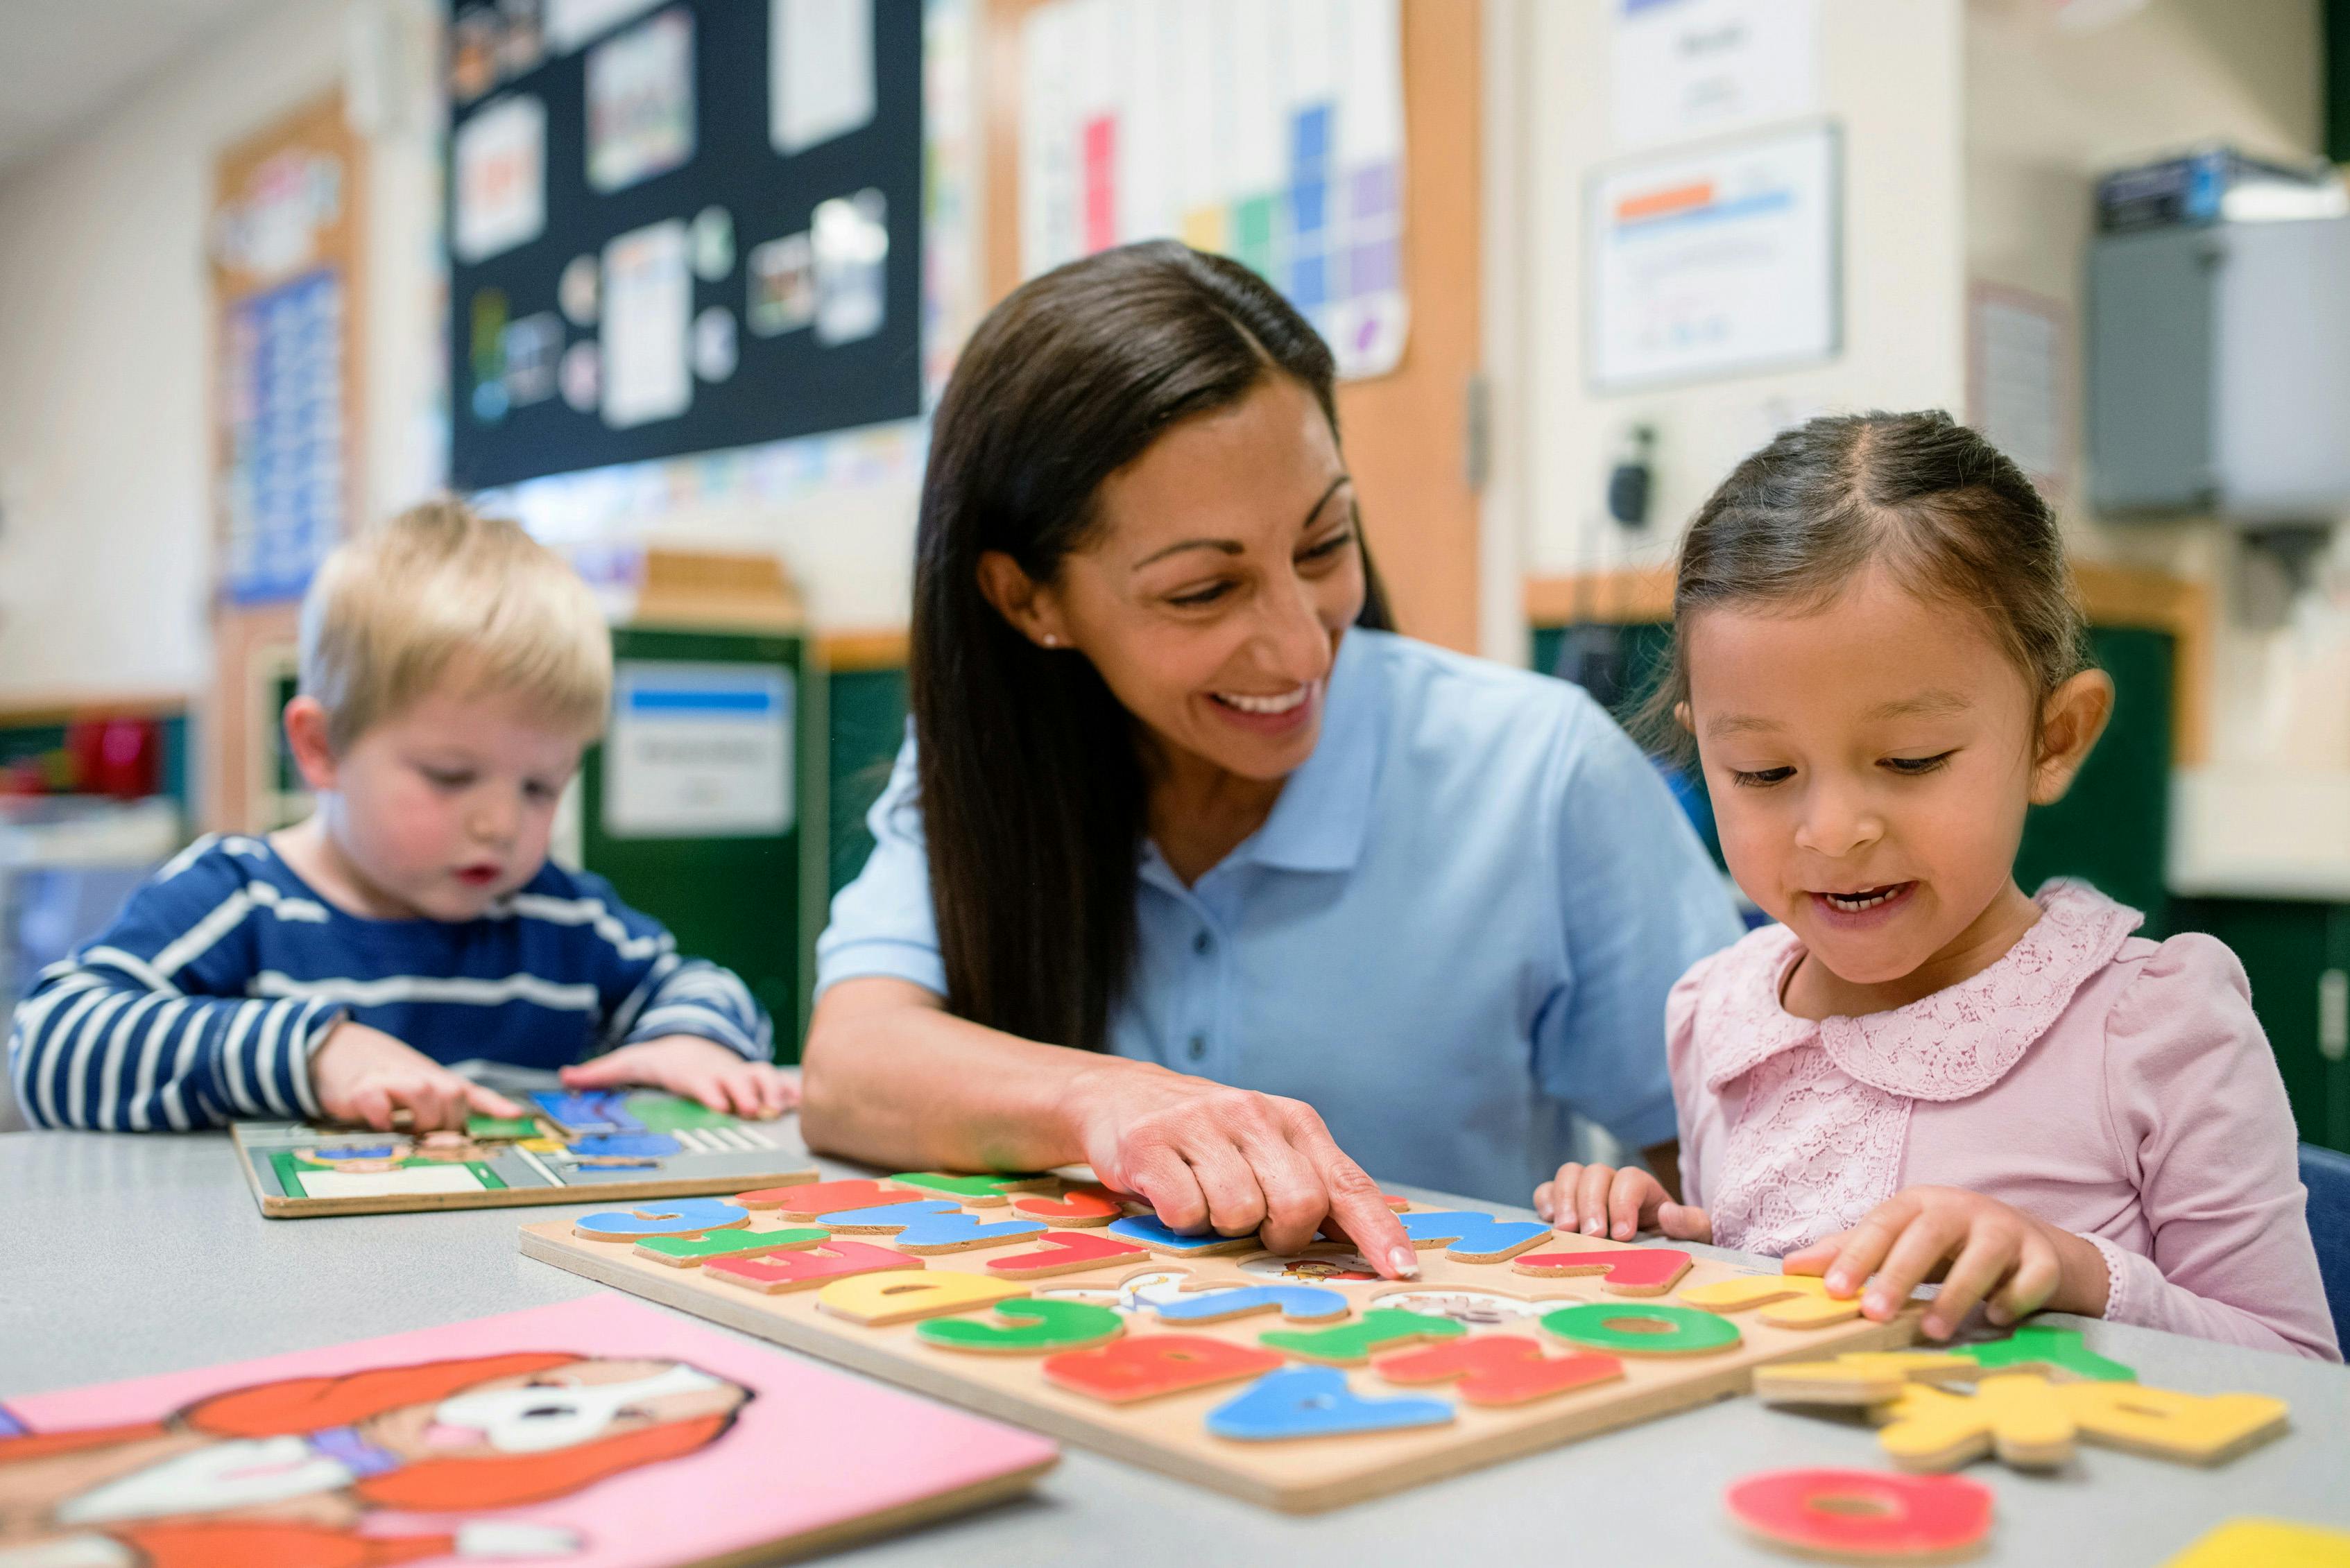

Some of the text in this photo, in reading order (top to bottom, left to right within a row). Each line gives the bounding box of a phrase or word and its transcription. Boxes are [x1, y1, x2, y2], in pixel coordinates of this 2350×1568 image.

[635, 1228, 830, 1263] F
[702, 1241, 925, 1288] E
[986, 1232, 1150, 1275] L
[817, 1270, 1031, 1323] D
[916, 1298, 1124, 1350] C
[1043, 1334, 1285, 1401] B
[1207, 1365, 1455, 1438] A
